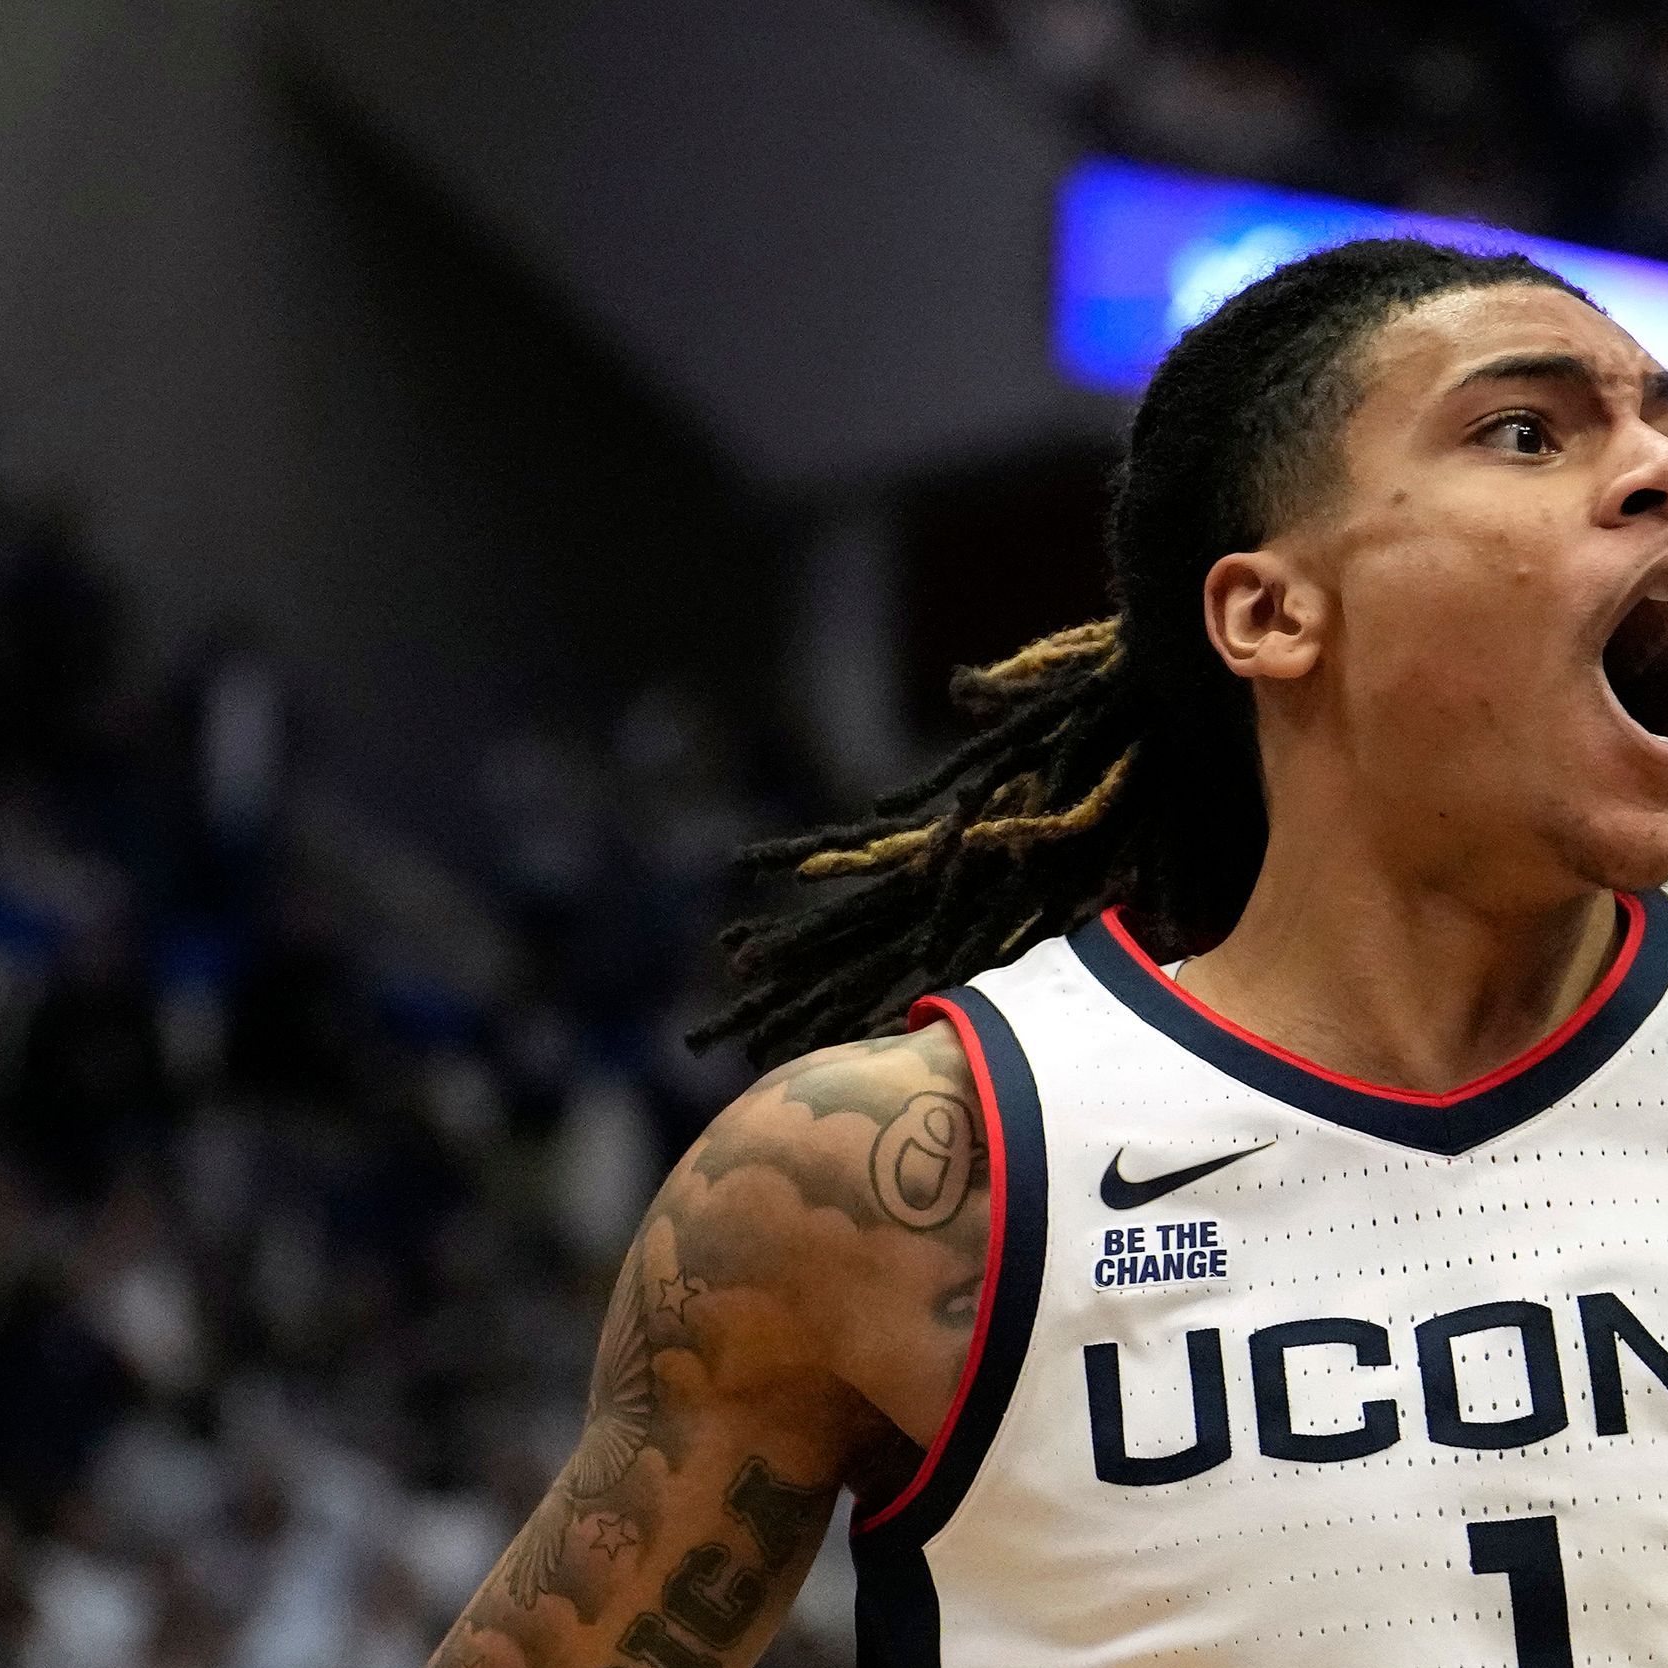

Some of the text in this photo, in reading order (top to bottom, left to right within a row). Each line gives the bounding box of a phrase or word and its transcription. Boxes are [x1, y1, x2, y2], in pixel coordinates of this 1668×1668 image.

[1104, 1221, 1218, 1256] BE THE
[1094, 1249, 1228, 1288] CHANGE
